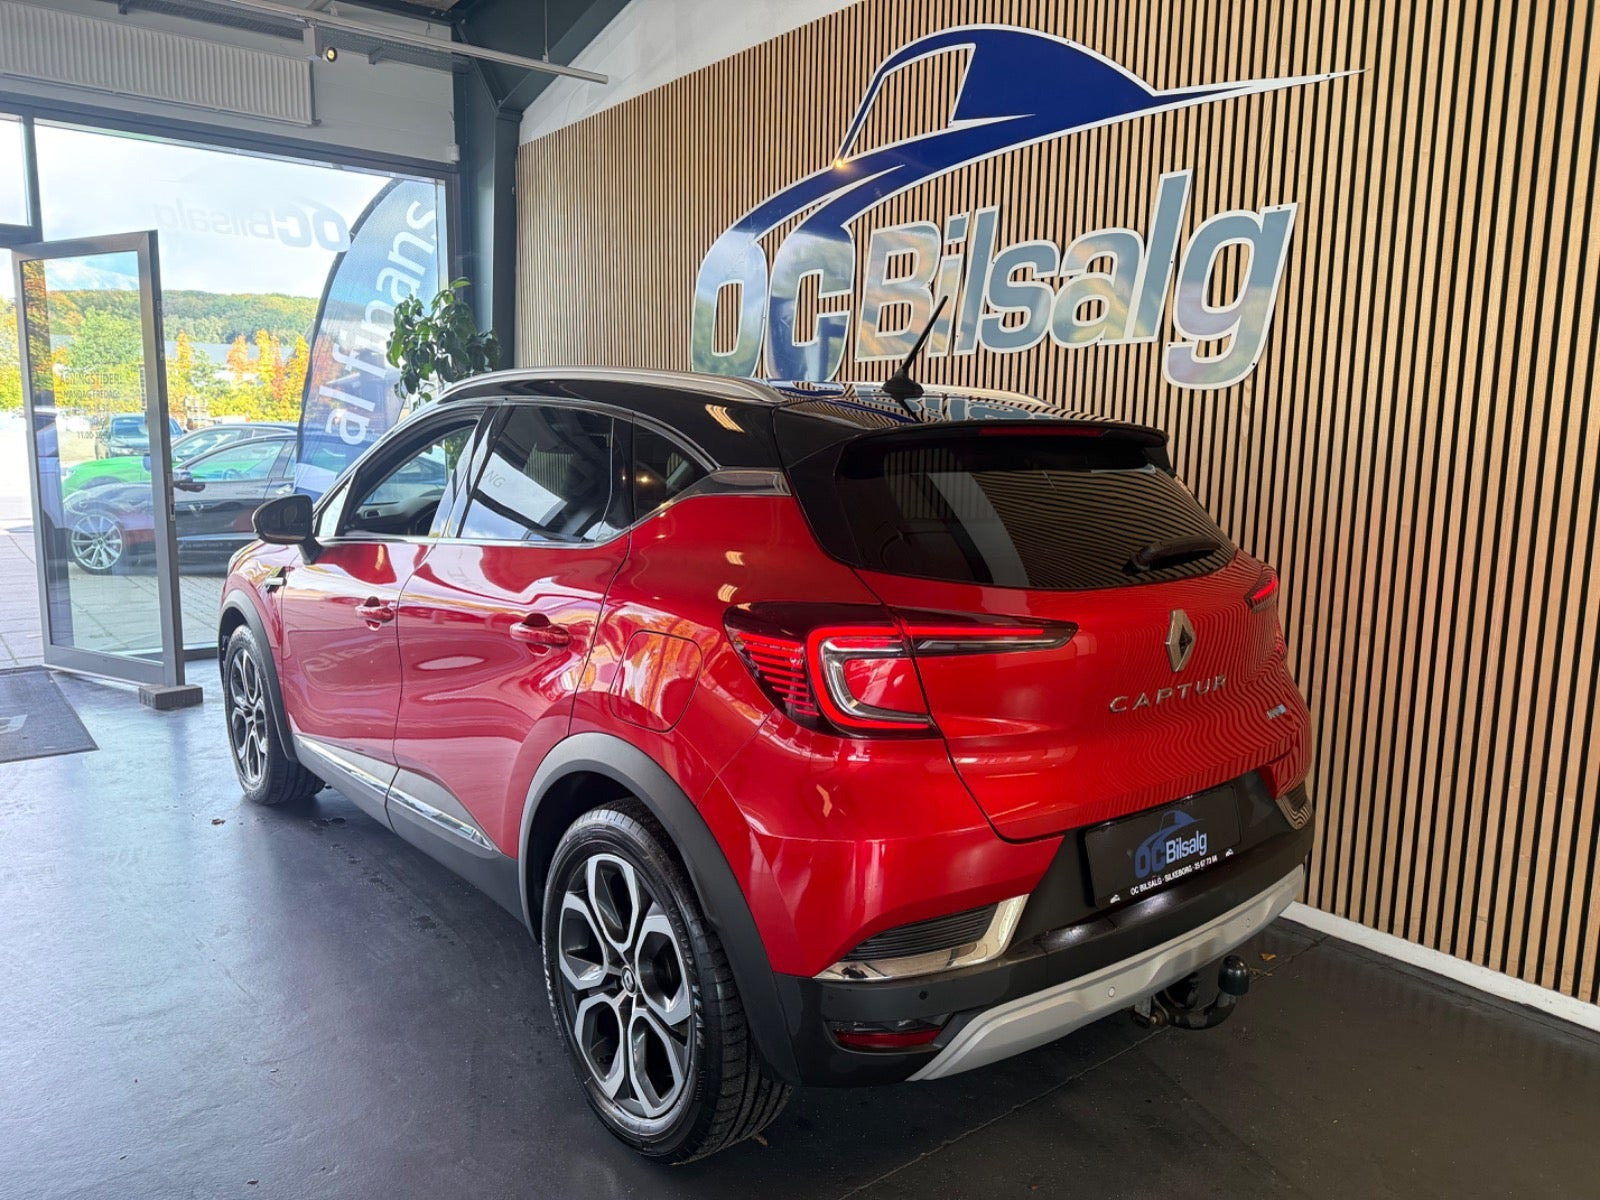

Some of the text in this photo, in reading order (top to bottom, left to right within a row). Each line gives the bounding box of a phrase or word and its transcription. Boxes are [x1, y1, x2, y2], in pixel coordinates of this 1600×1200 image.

[1109, 674, 1226, 713] CAPTUR
[1139, 877, 1162, 892] BILSALG
[1164, 864, 1193, 882] SILKEBORG
